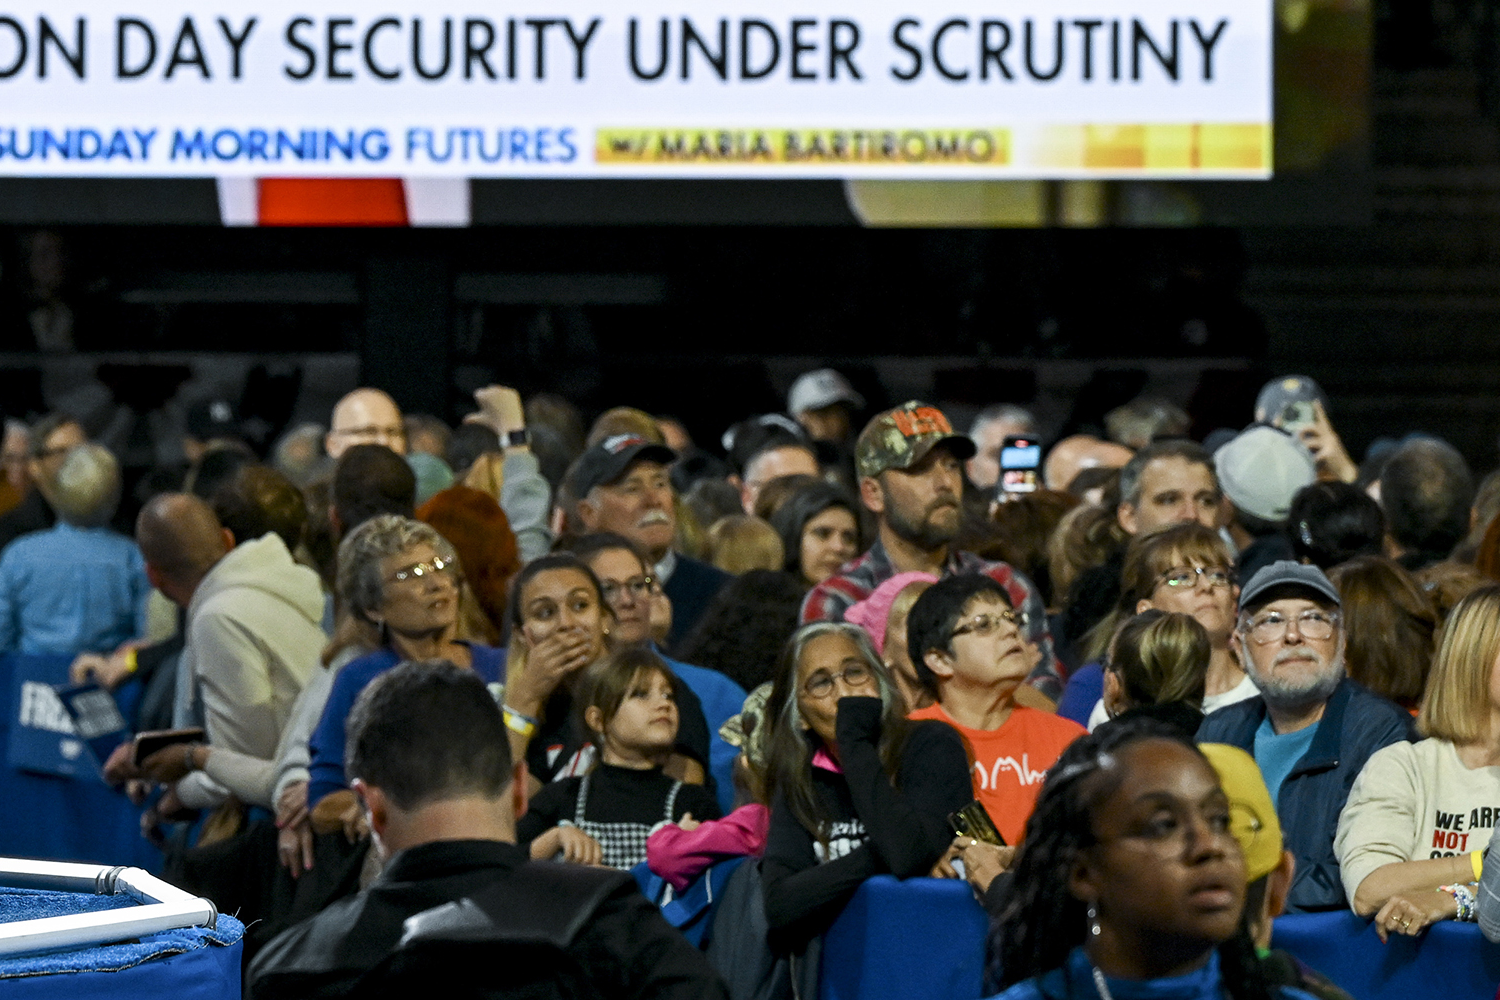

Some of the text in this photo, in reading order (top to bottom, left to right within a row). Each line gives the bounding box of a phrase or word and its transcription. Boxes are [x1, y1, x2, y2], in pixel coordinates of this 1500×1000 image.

[117, 17, 255, 79] DAY
[285, 17, 600, 81] SECURITY
[628, 18, 863, 82] UNDER
[890, 18, 1228, 82] SCRUTINY
[169, 125, 393, 164] MORNING
[405, 126, 580, 165] FUTURES
[653, 129, 772, 161] MARIA
[783, 129, 997, 163] BARTIROMO
[1435, 809, 1465, 832] WE
[1432, 829, 1470, 853] NOT
